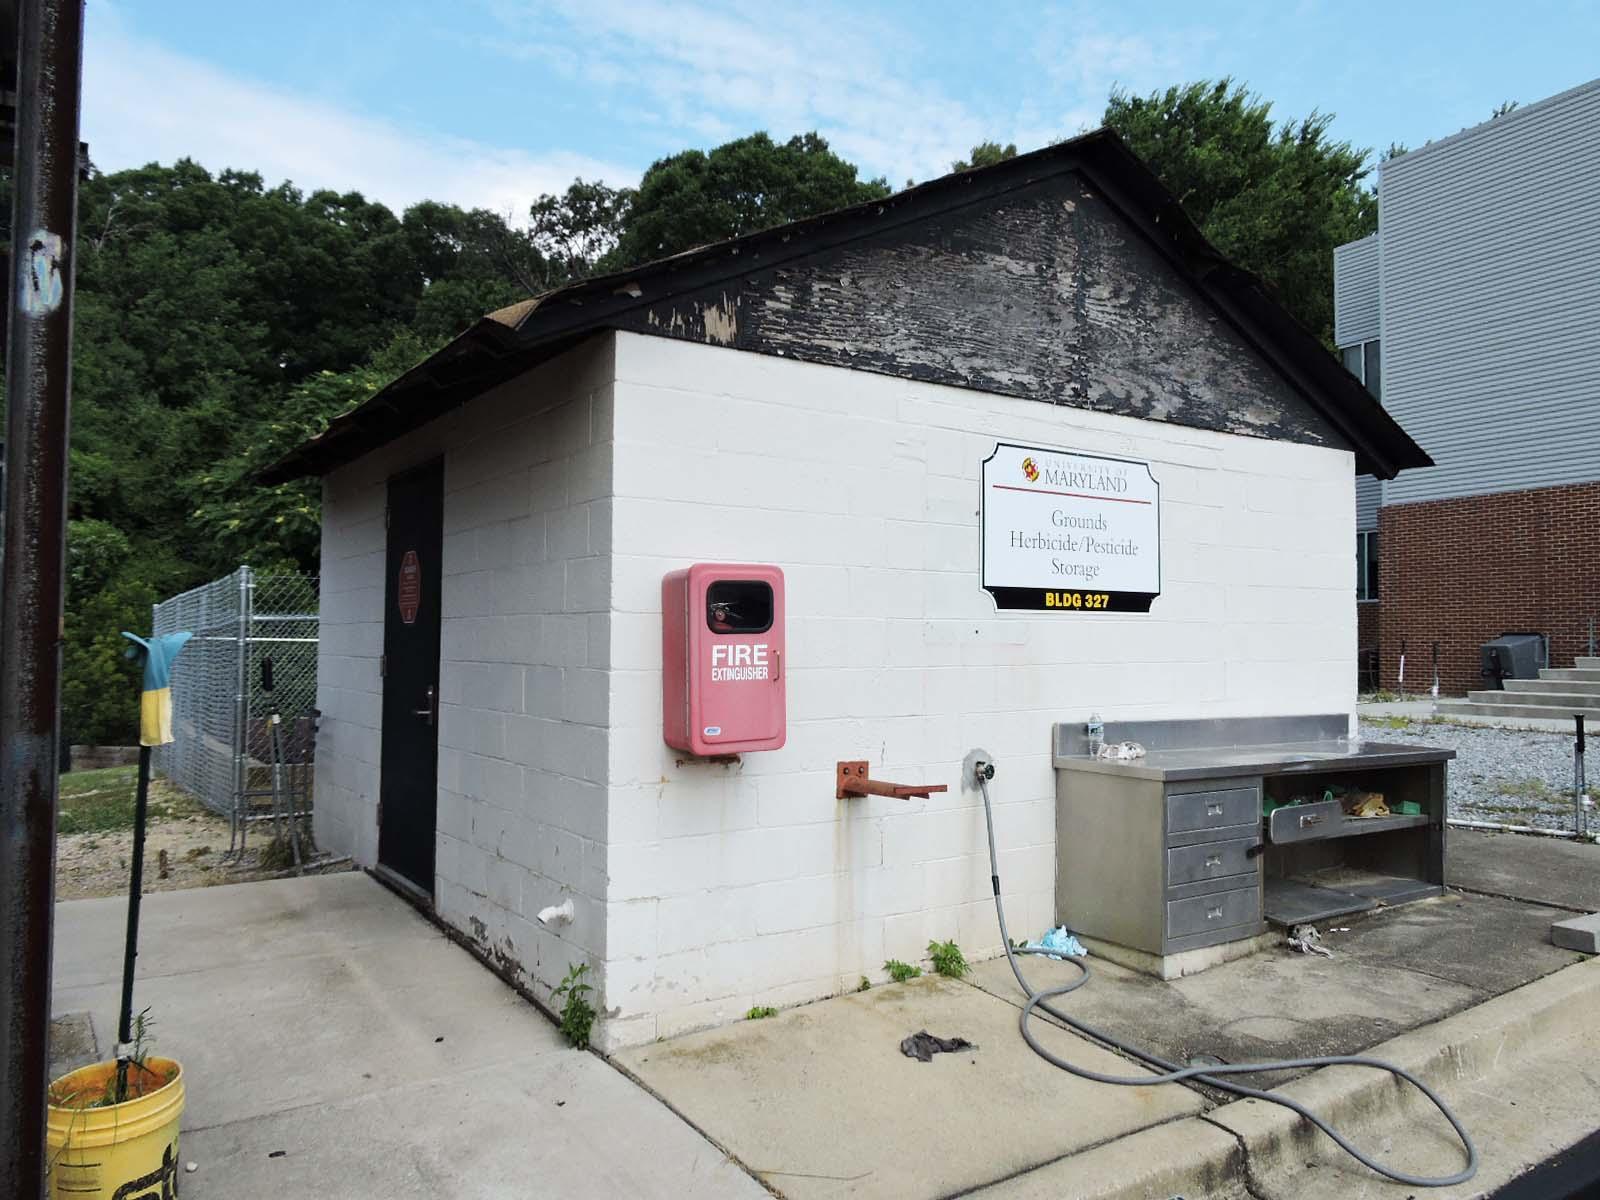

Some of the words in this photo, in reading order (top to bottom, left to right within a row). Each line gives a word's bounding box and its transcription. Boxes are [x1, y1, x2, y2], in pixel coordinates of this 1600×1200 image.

[1045, 457, 1110, 475] UNIVERSITY
[1045, 469, 1128, 493] MARYLAND
[1051, 509, 1108, 531] Grounds
[1010, 530, 1139, 557] Herbicide/Pesticide
[1051, 558, 1100, 582] Storage
[1045, 592, 1082, 607] BLDG
[1085, 594, 1110, 608] 327
[712, 644, 769, 666] FIRE
[712, 667, 769, 682] EXTINGUISHER
